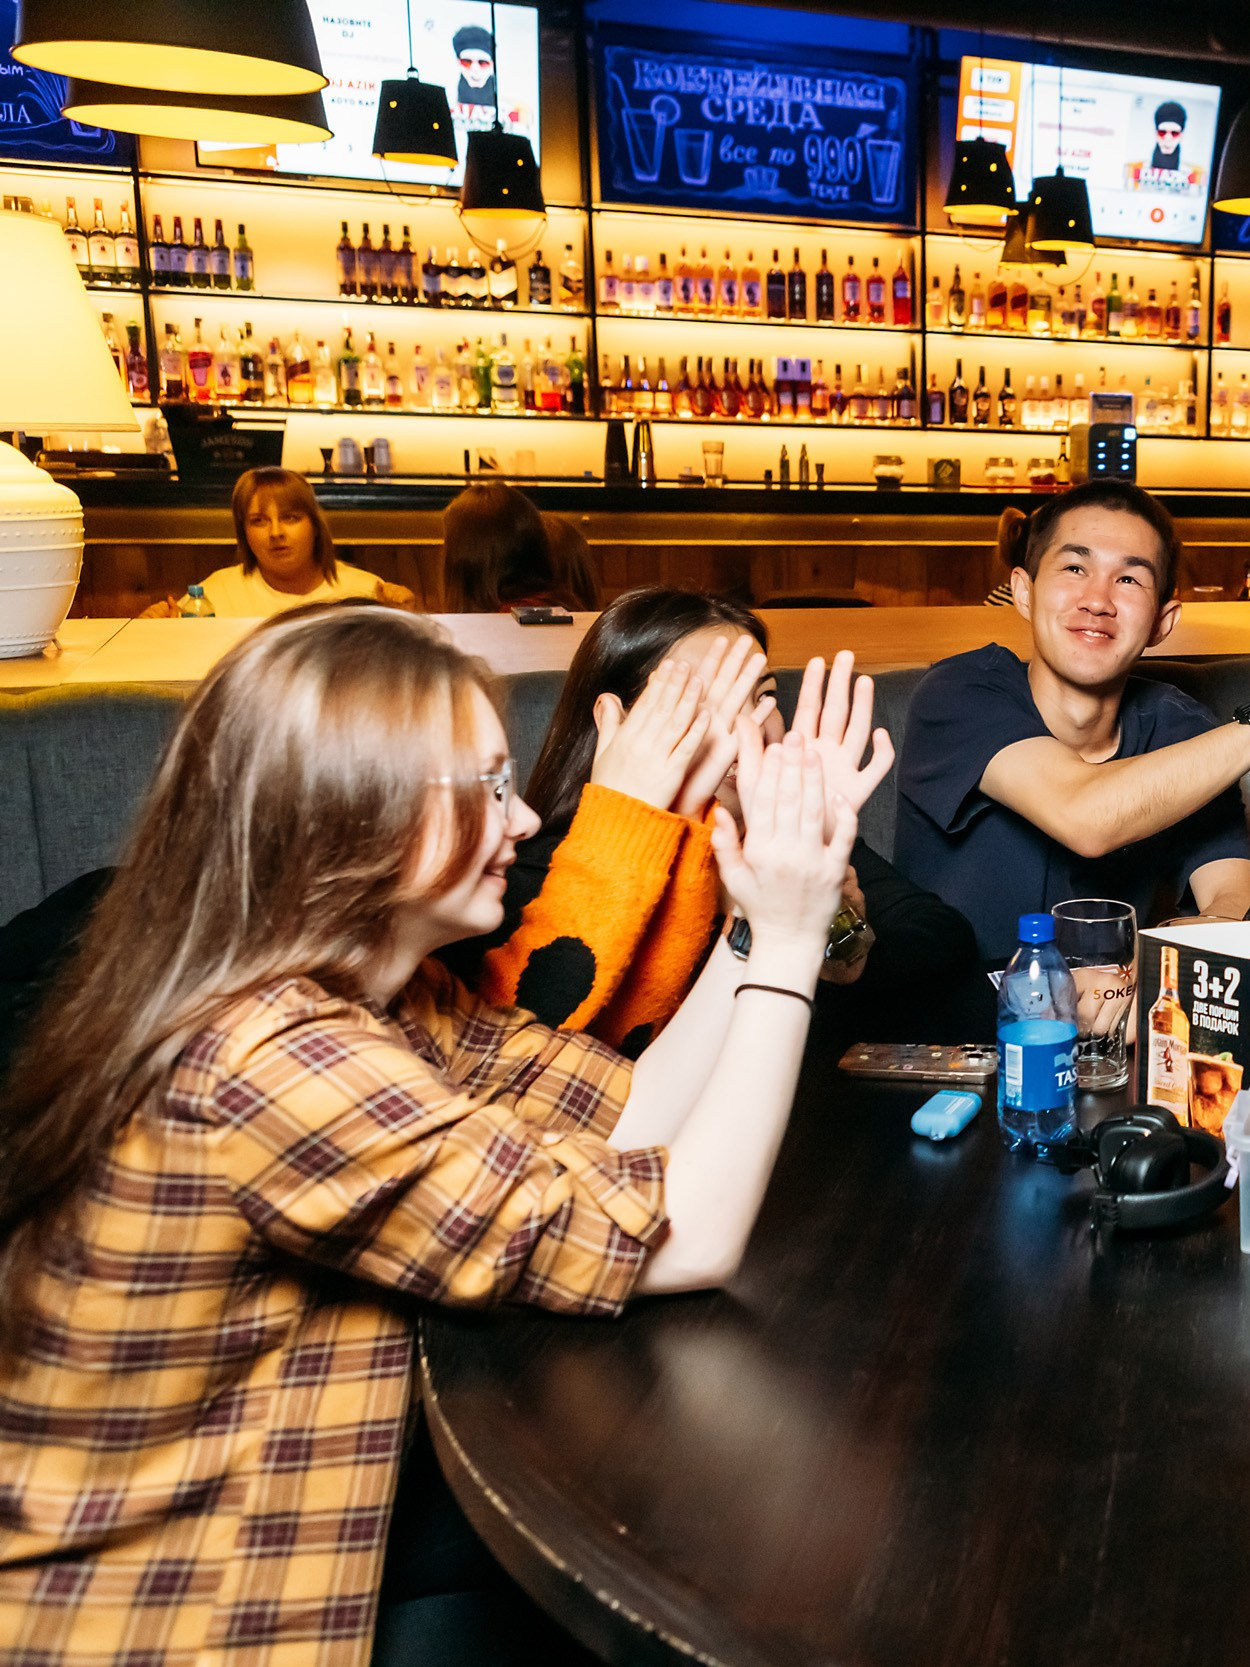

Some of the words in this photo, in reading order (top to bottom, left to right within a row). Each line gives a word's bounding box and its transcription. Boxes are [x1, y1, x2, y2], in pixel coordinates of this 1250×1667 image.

[701, 93, 824, 134] СРЕДА
[803, 133, 863, 185] 990
[1192, 959, 1241, 1008] 3+2
[1192, 1000, 1207, 1015] ДВЕ
[1208, 1003, 1240, 1023] ПОРЦИИ
[1192, 1013, 1199, 1026] В
[1199, 1015, 1240, 1037] ПОДАРОК
